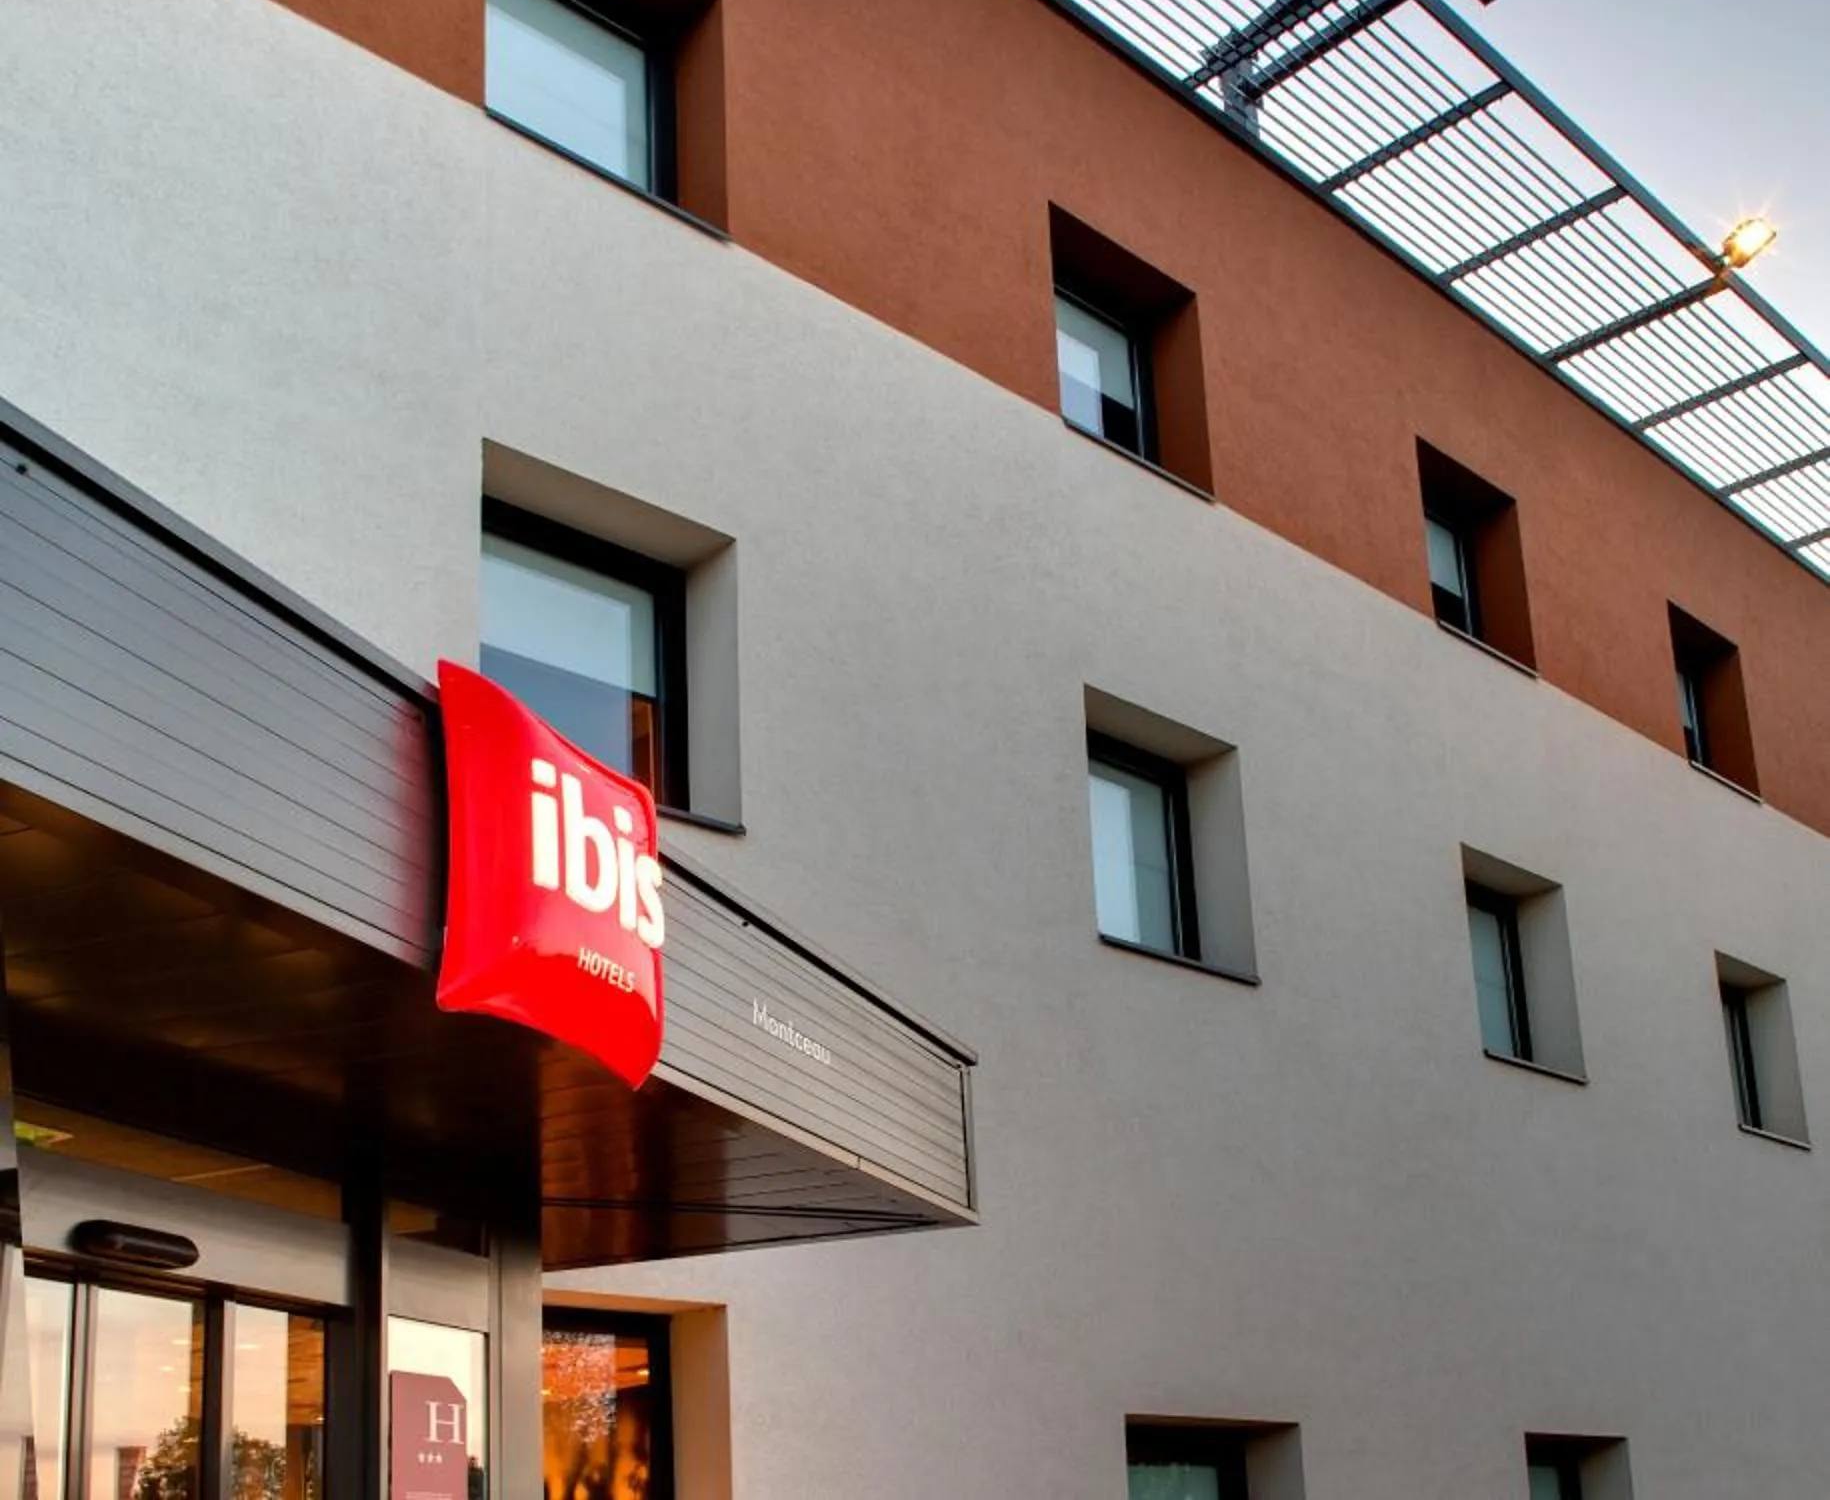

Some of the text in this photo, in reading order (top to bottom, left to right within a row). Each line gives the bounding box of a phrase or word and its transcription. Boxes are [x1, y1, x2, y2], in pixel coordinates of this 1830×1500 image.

[531, 757, 666, 949] ibis
[577, 947, 637, 993] HOTELS
[753, 998, 831, 1064] Montceau
[424, 1400, 465, 1445] H
